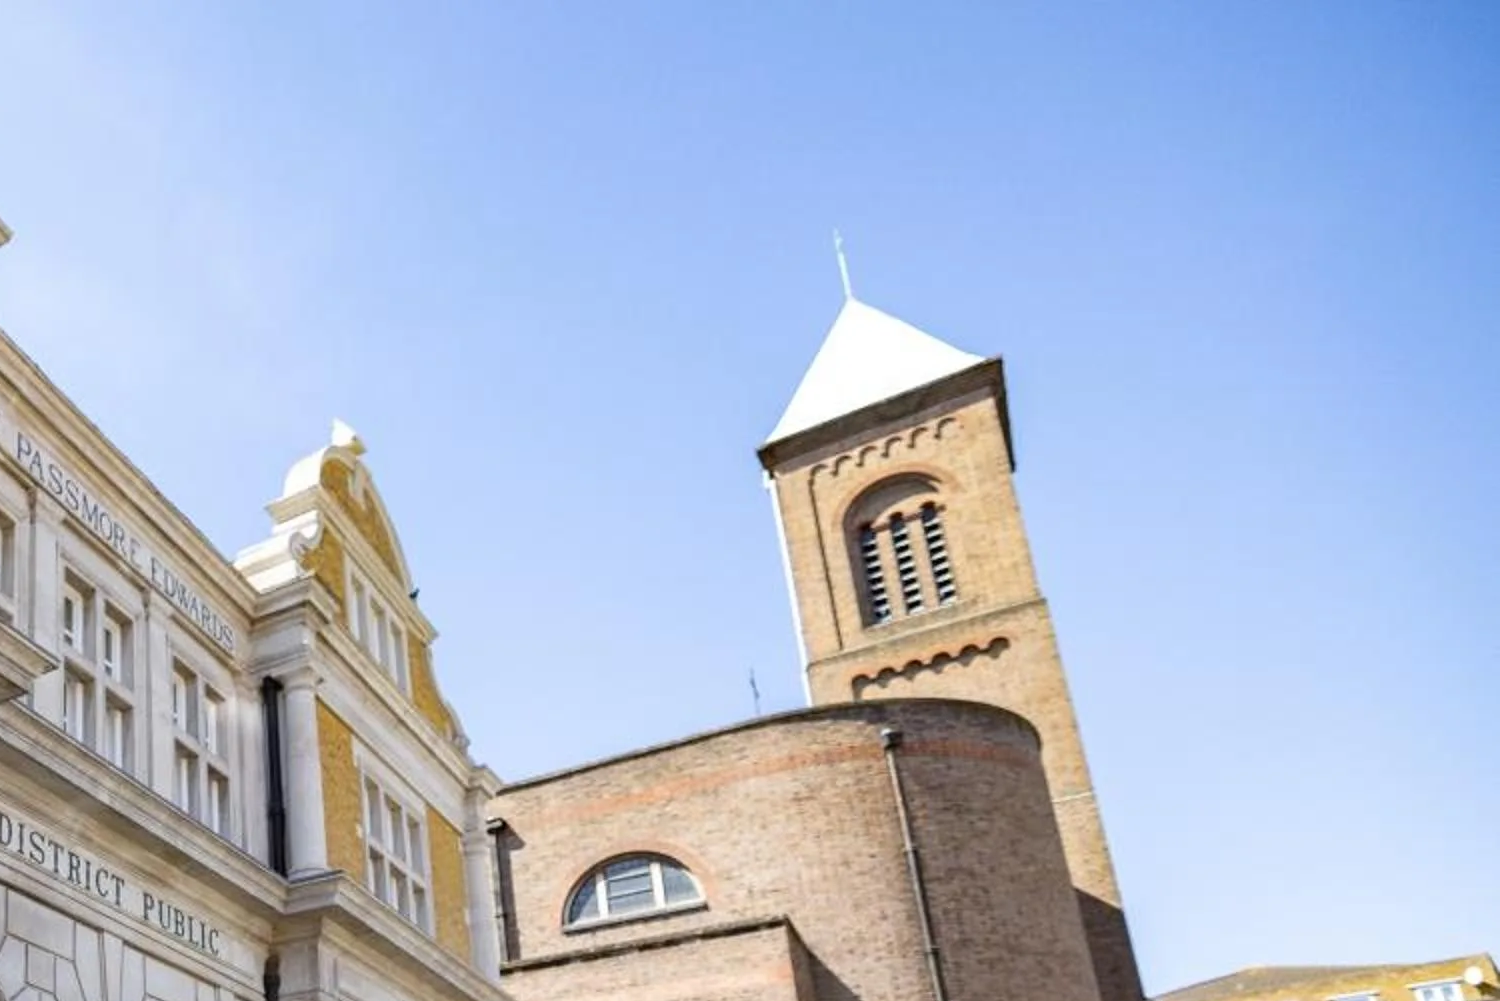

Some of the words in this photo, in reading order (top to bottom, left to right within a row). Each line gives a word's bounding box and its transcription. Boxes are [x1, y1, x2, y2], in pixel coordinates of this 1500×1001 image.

[16, 431, 142, 570] PASSMORE
[150, 556, 235, 651] EDWARDS
[142, 891, 220, 956] PUBLIC
